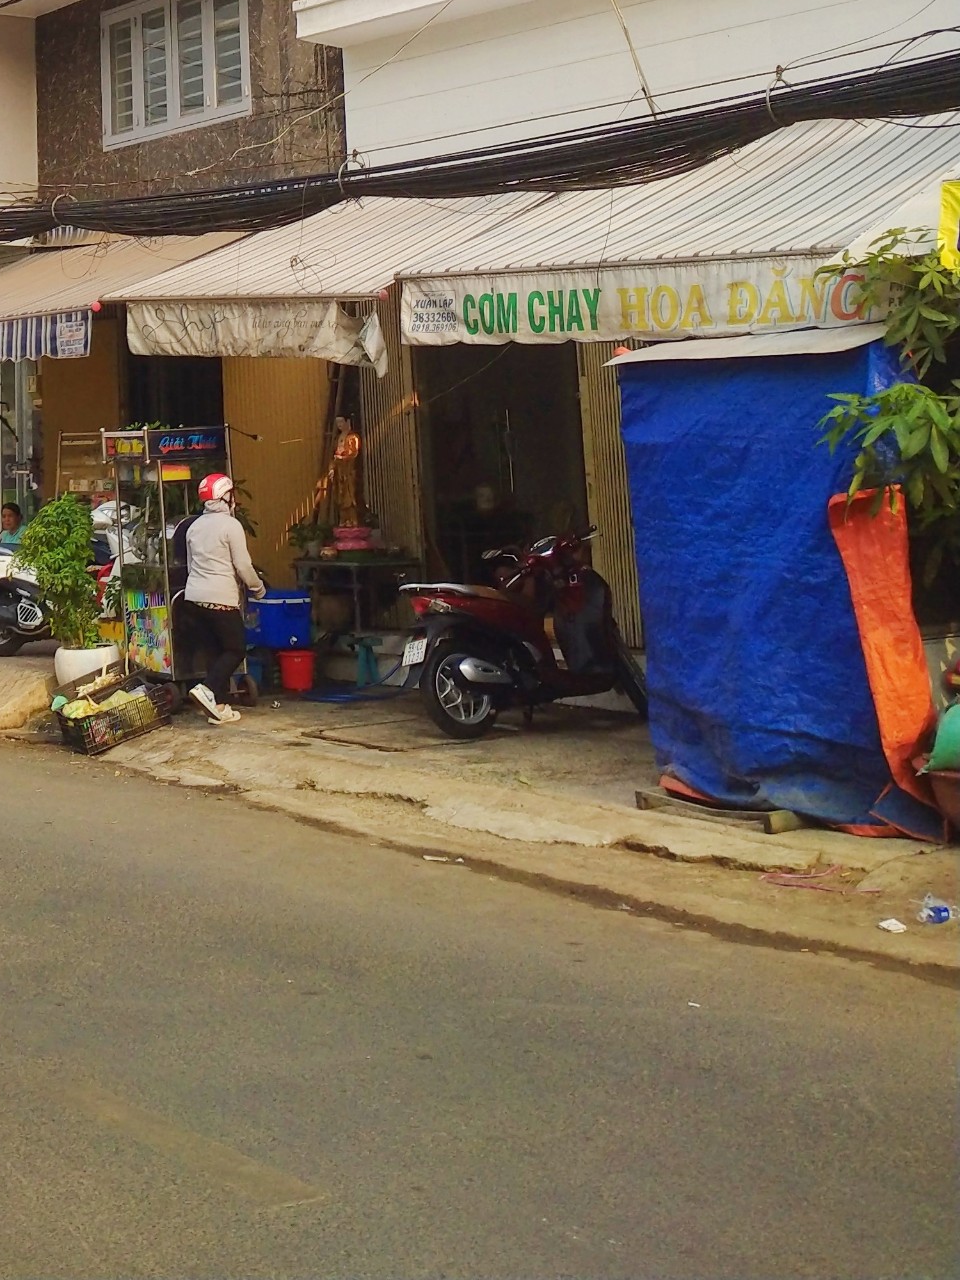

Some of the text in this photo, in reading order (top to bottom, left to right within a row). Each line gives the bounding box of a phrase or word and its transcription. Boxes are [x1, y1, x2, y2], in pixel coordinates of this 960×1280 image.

[462, 287, 518, 335] CƠM
[527, 288, 600, 334] CHAY
[616, 283, 714, 331] HOA
